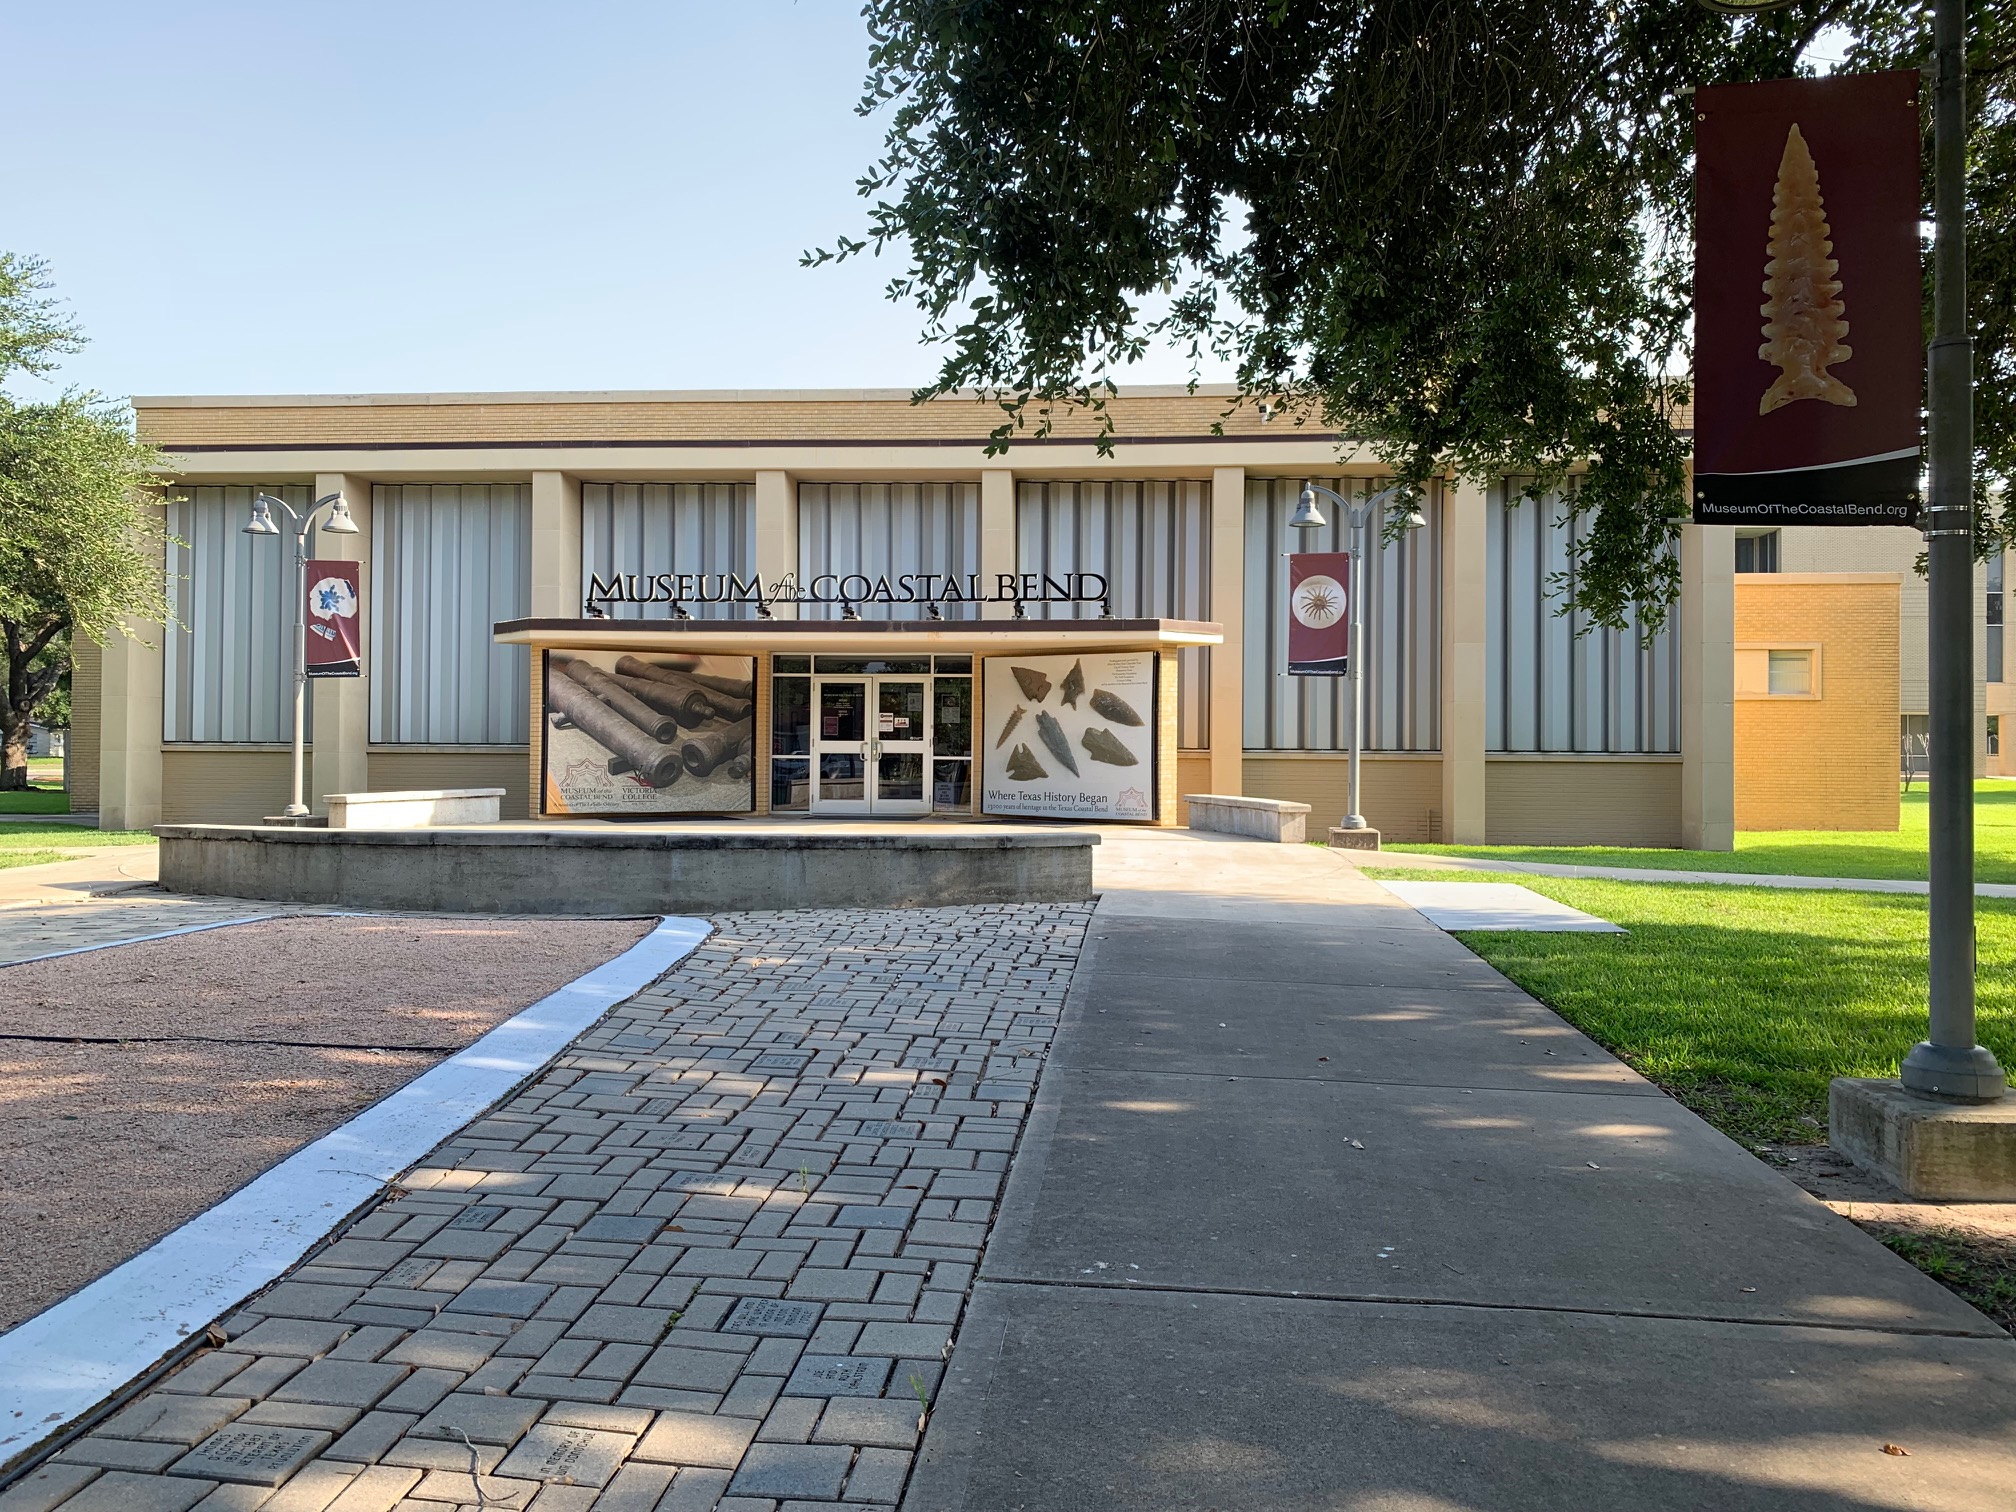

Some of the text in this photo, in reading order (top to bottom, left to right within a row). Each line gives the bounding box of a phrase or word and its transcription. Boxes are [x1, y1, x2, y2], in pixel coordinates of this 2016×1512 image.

[1702, 503, 1907, 518] MuseumOfTheCoastalBend.org
[586, 572, 764, 603] MUSEUM
[769, 572, 794, 606] of
[810, 573, 988, 603] COASTAL
[995, 572, 1109, 603] BEND
[988, 790, 1108, 805] Where Texas History Began
[1022, 803, 1041, 812] heritage
[195, 1434, 231, 1456] THOMAS
[208, 1432, 250, 1461] O'CONNOR
[236, 1432, 283, 1466] VETERAN OF
[260, 1441, 290, 1460] TEXAS
[267, 1435, 314, 1469] REVOLUTION
[540, 1430, 581, 1475] IN MEMORY OF
